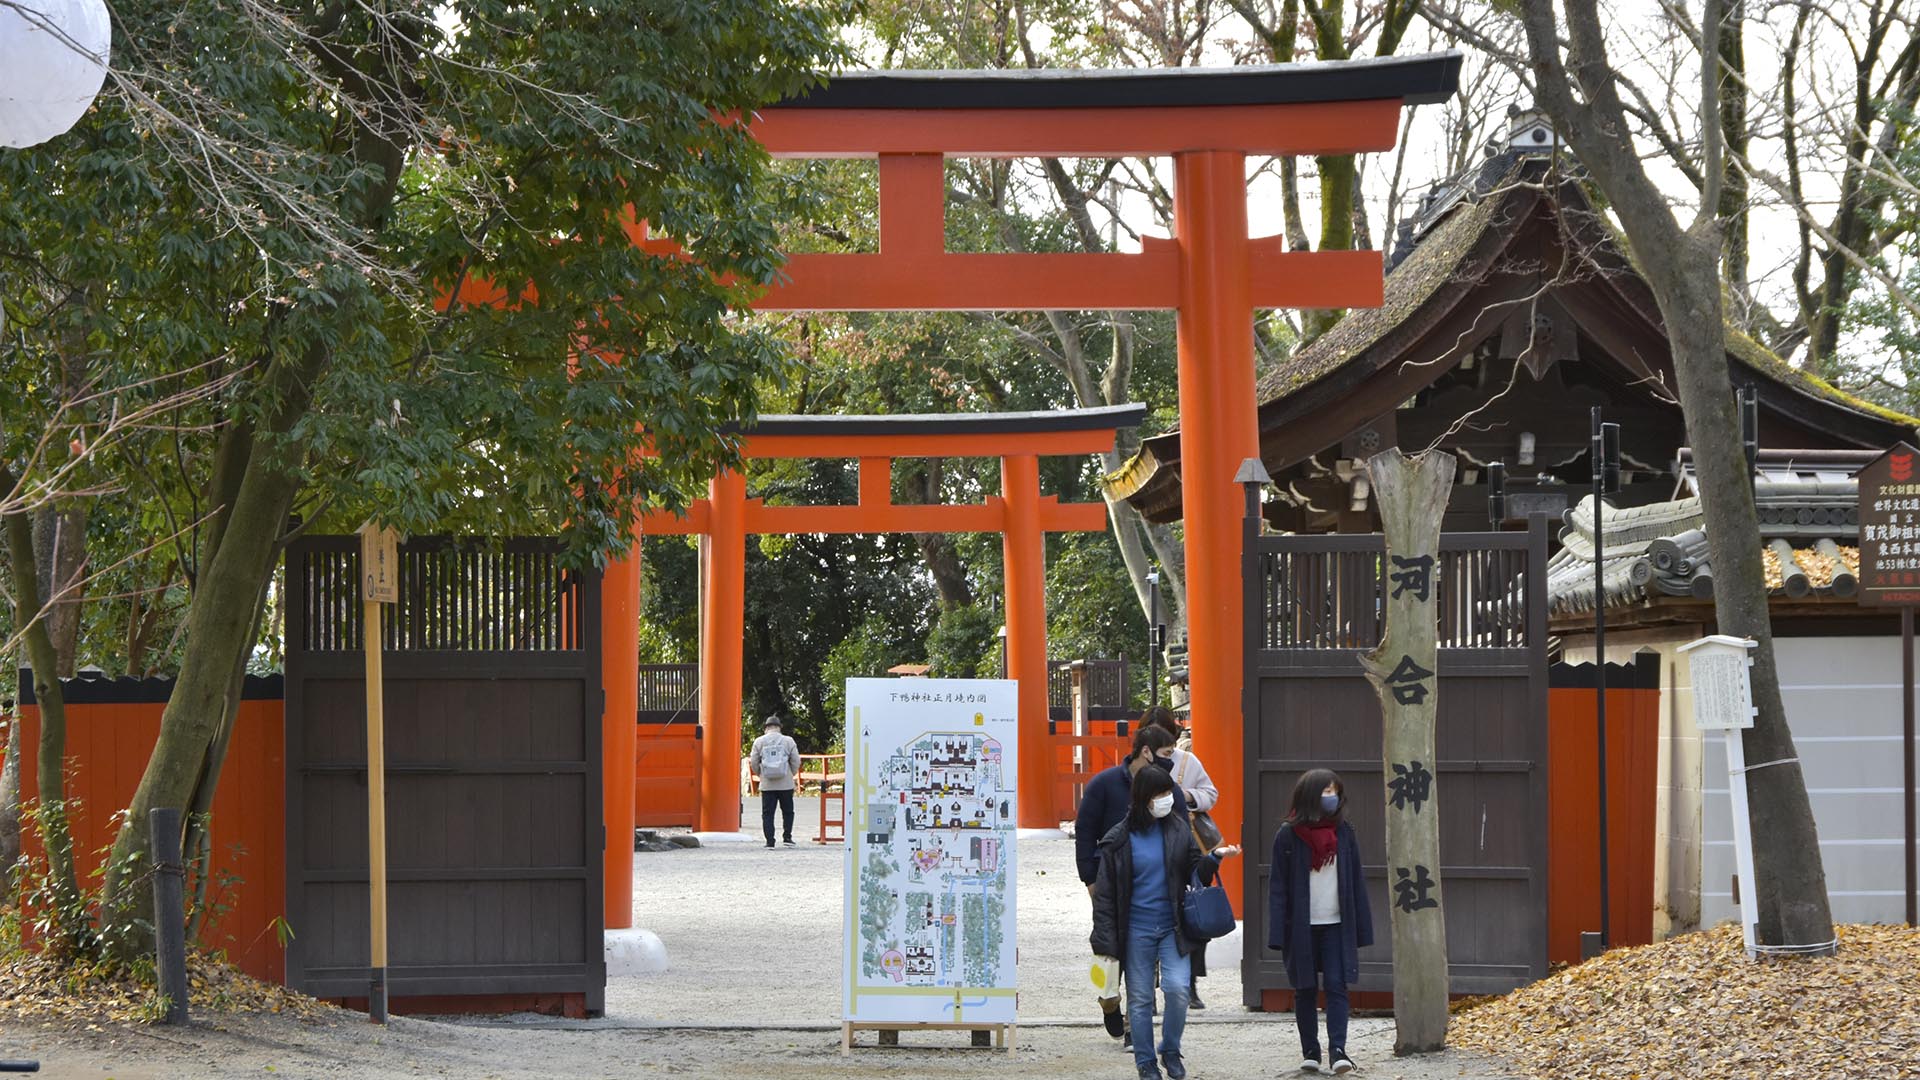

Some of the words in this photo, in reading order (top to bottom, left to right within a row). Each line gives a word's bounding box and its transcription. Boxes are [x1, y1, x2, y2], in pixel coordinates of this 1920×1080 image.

[890, 692, 986, 704] 下鴨神社正月境内図
[1385, 554, 1438, 913] 河合神社
